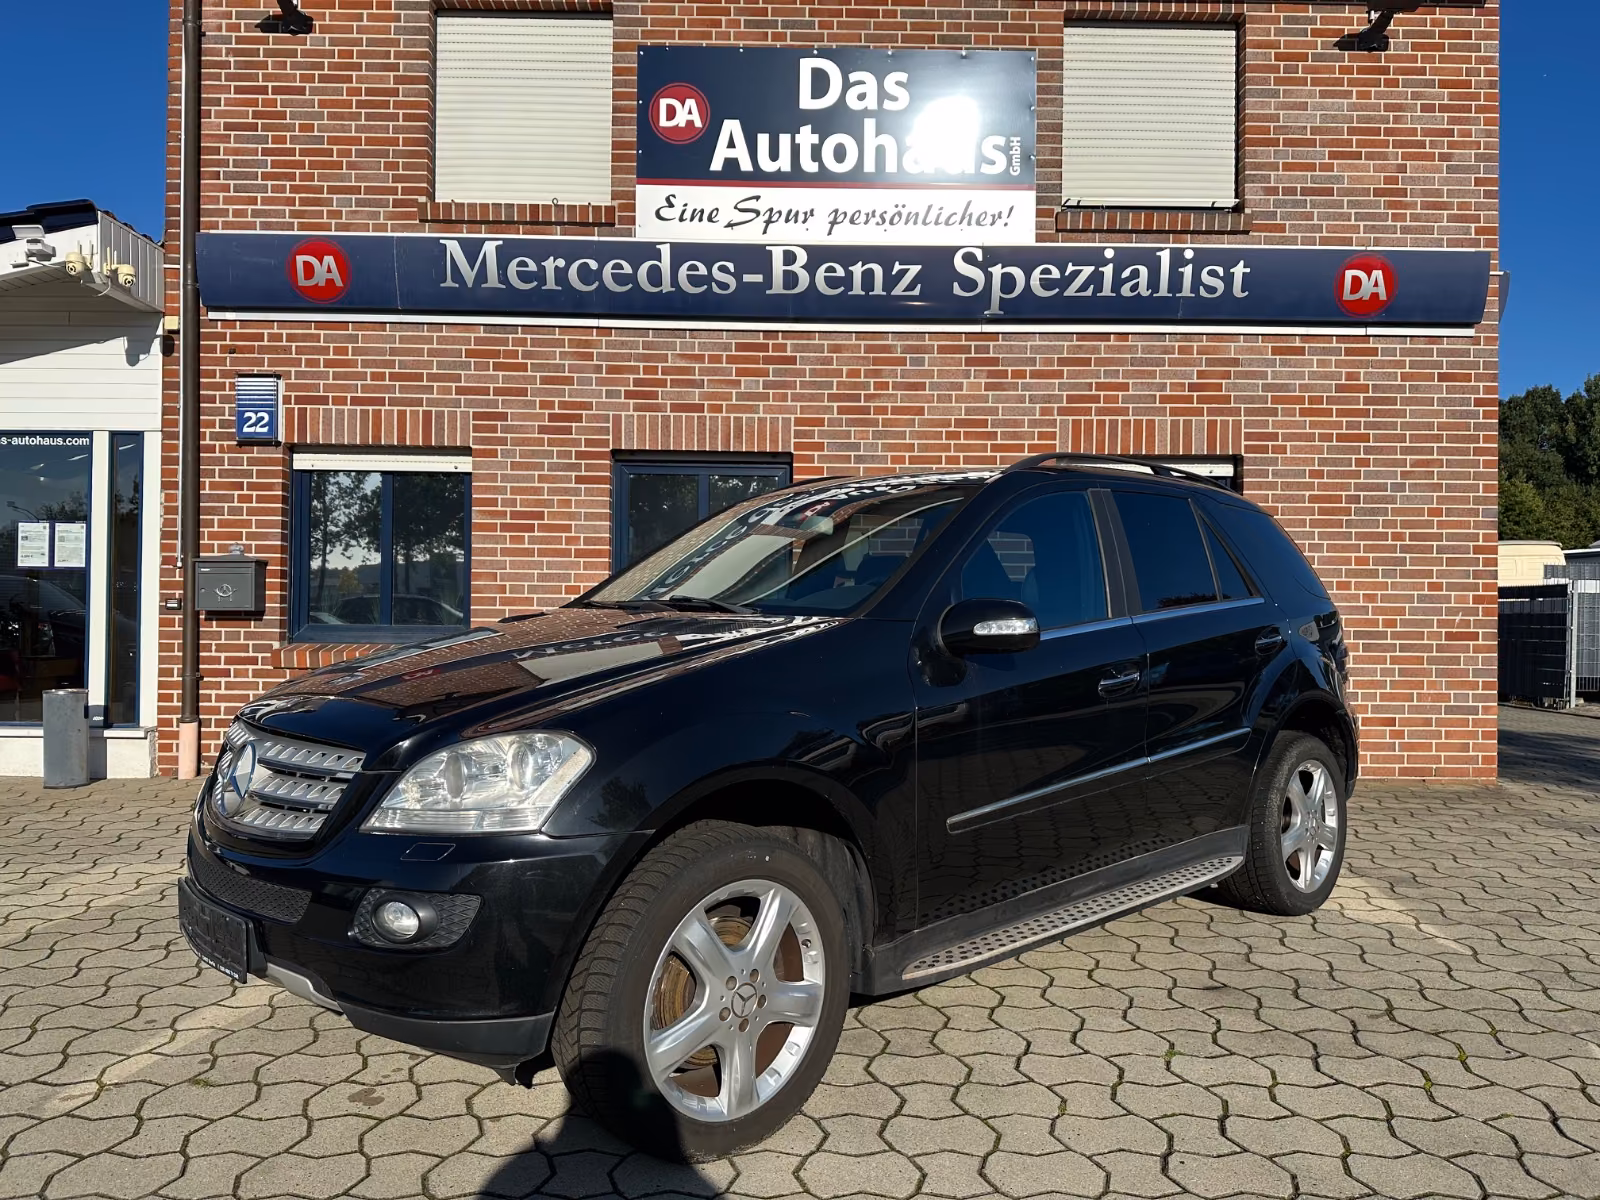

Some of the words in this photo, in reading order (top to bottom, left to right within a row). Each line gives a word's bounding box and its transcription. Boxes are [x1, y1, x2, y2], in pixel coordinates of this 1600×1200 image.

[799, 57, 910, 110] Das
[658, 98, 702, 127] DA
[1009, 136, 1021, 176] GmbH
[655, 194, 719, 224] Eine
[725, 195, 814, 236] Spur
[827, 201, 1013, 236] persönlicher!
[296, 255, 343, 287] DA
[439, 239, 922, 296] Mercedes-Benz
[952, 247, 1250, 315] Spezialist
[1343, 269, 1386, 300] DA
[242, 411, 270, 433] 22
